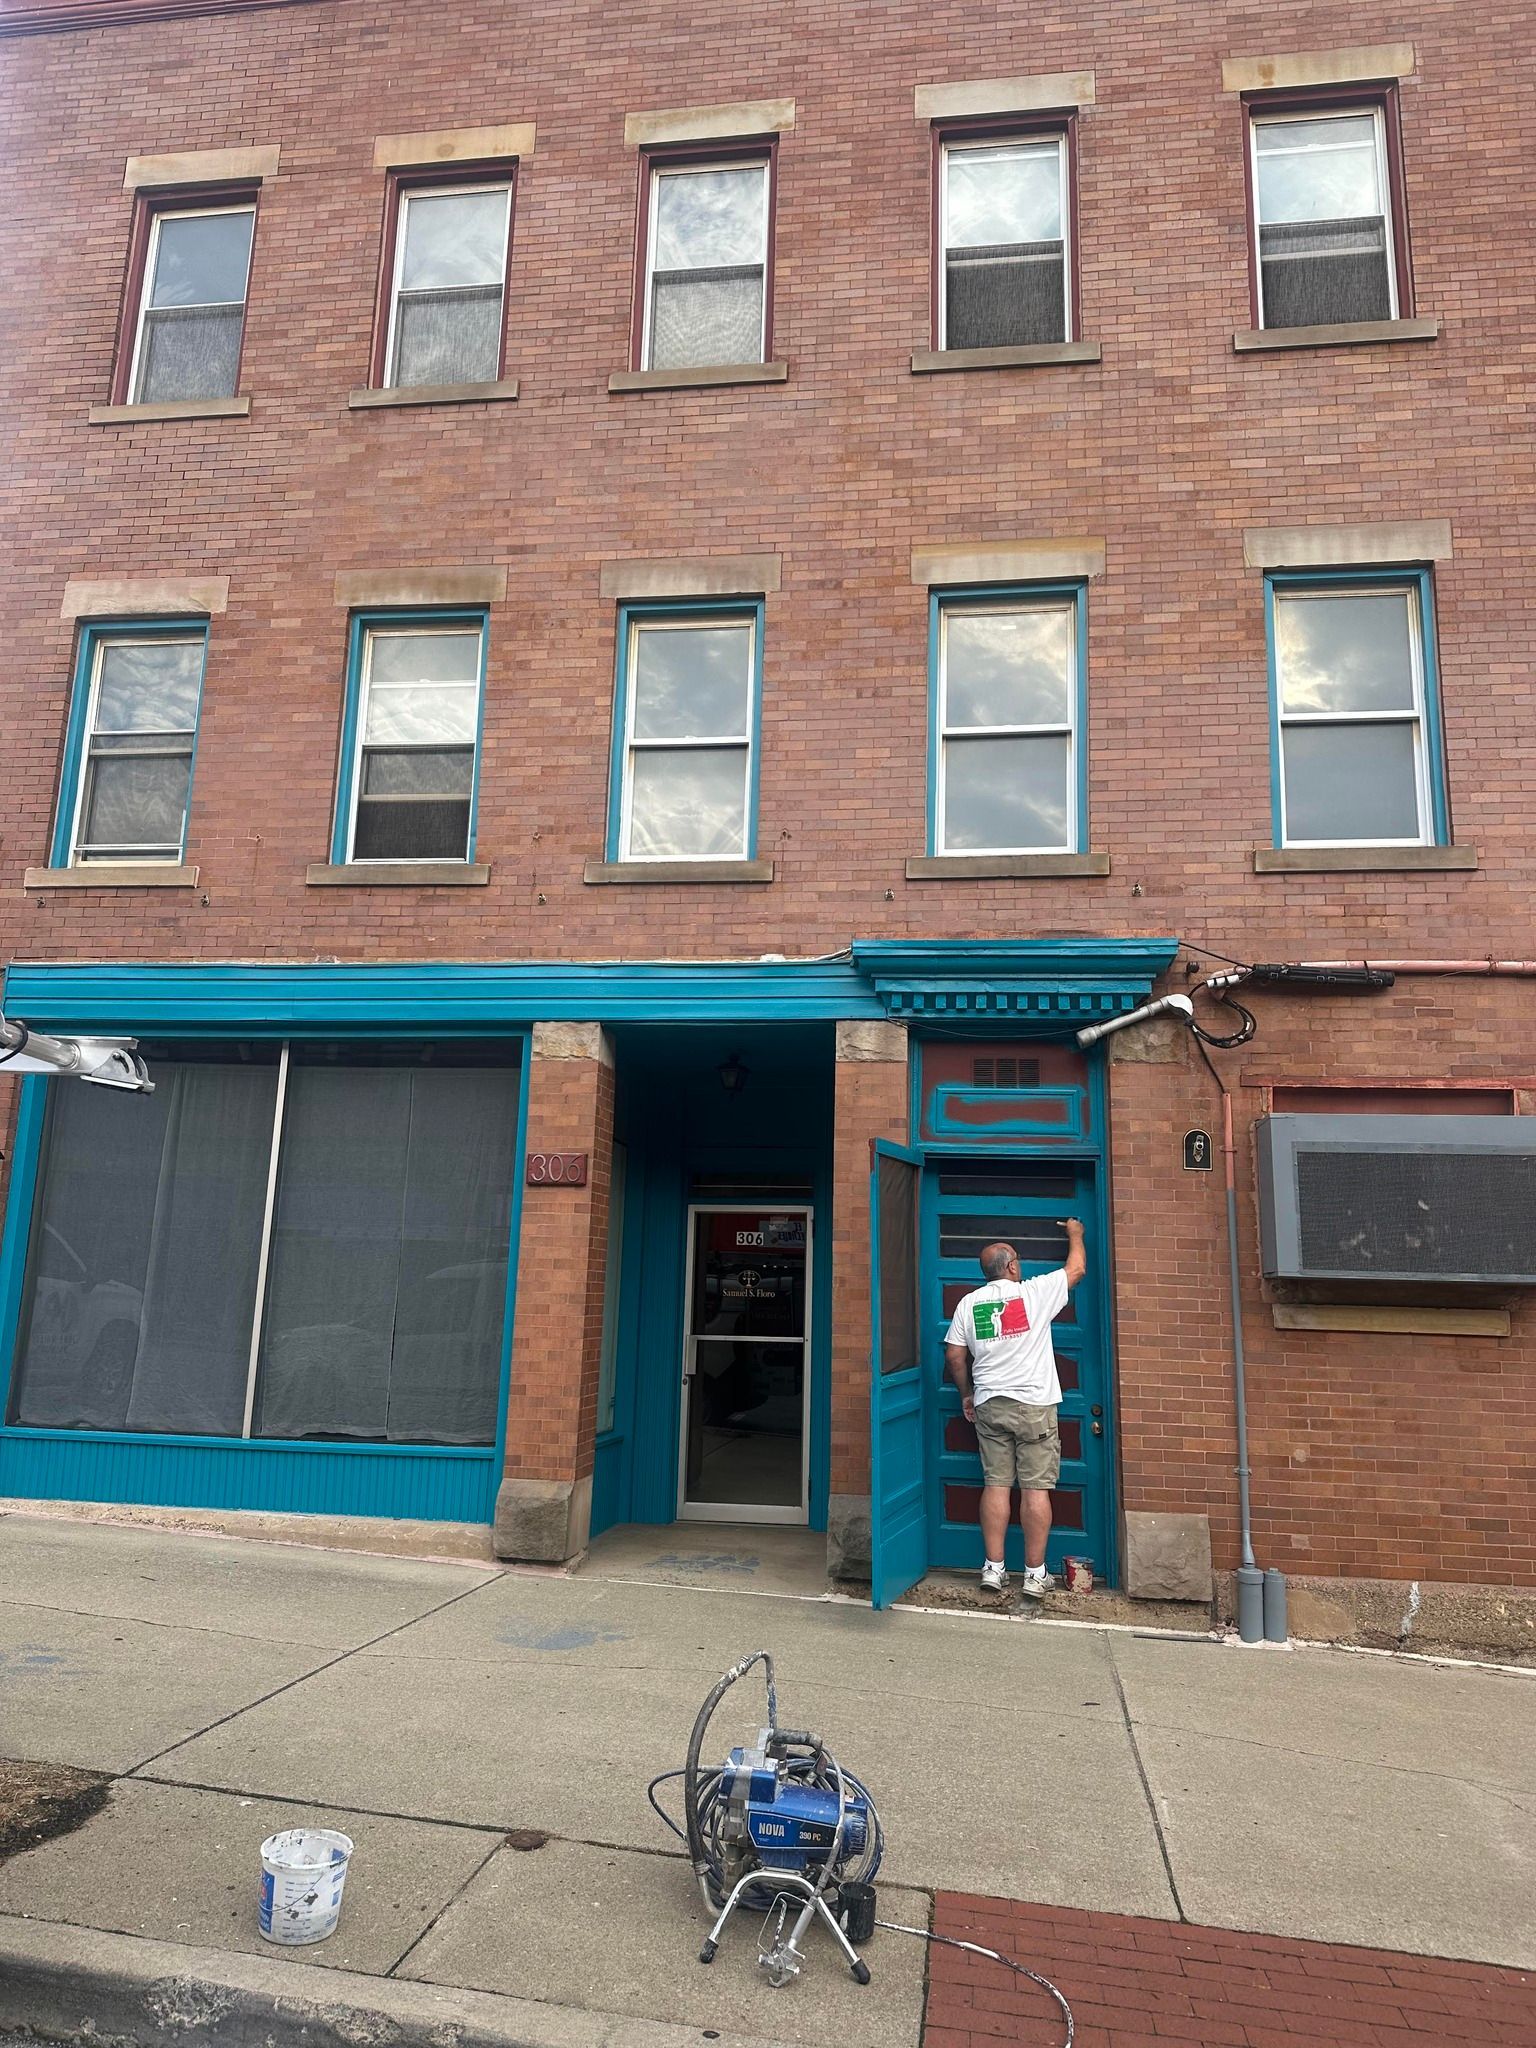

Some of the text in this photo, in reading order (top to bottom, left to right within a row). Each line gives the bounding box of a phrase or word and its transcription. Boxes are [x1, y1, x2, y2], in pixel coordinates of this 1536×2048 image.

[531, 1154, 584, 1182] 306
[737, 1232, 763, 1245] 306
[722, 1288, 776, 1298] Samuel S. Floro
[758, 1822, 785, 1837] NOVA
[799, 1831, 822, 1841] 390 PC
